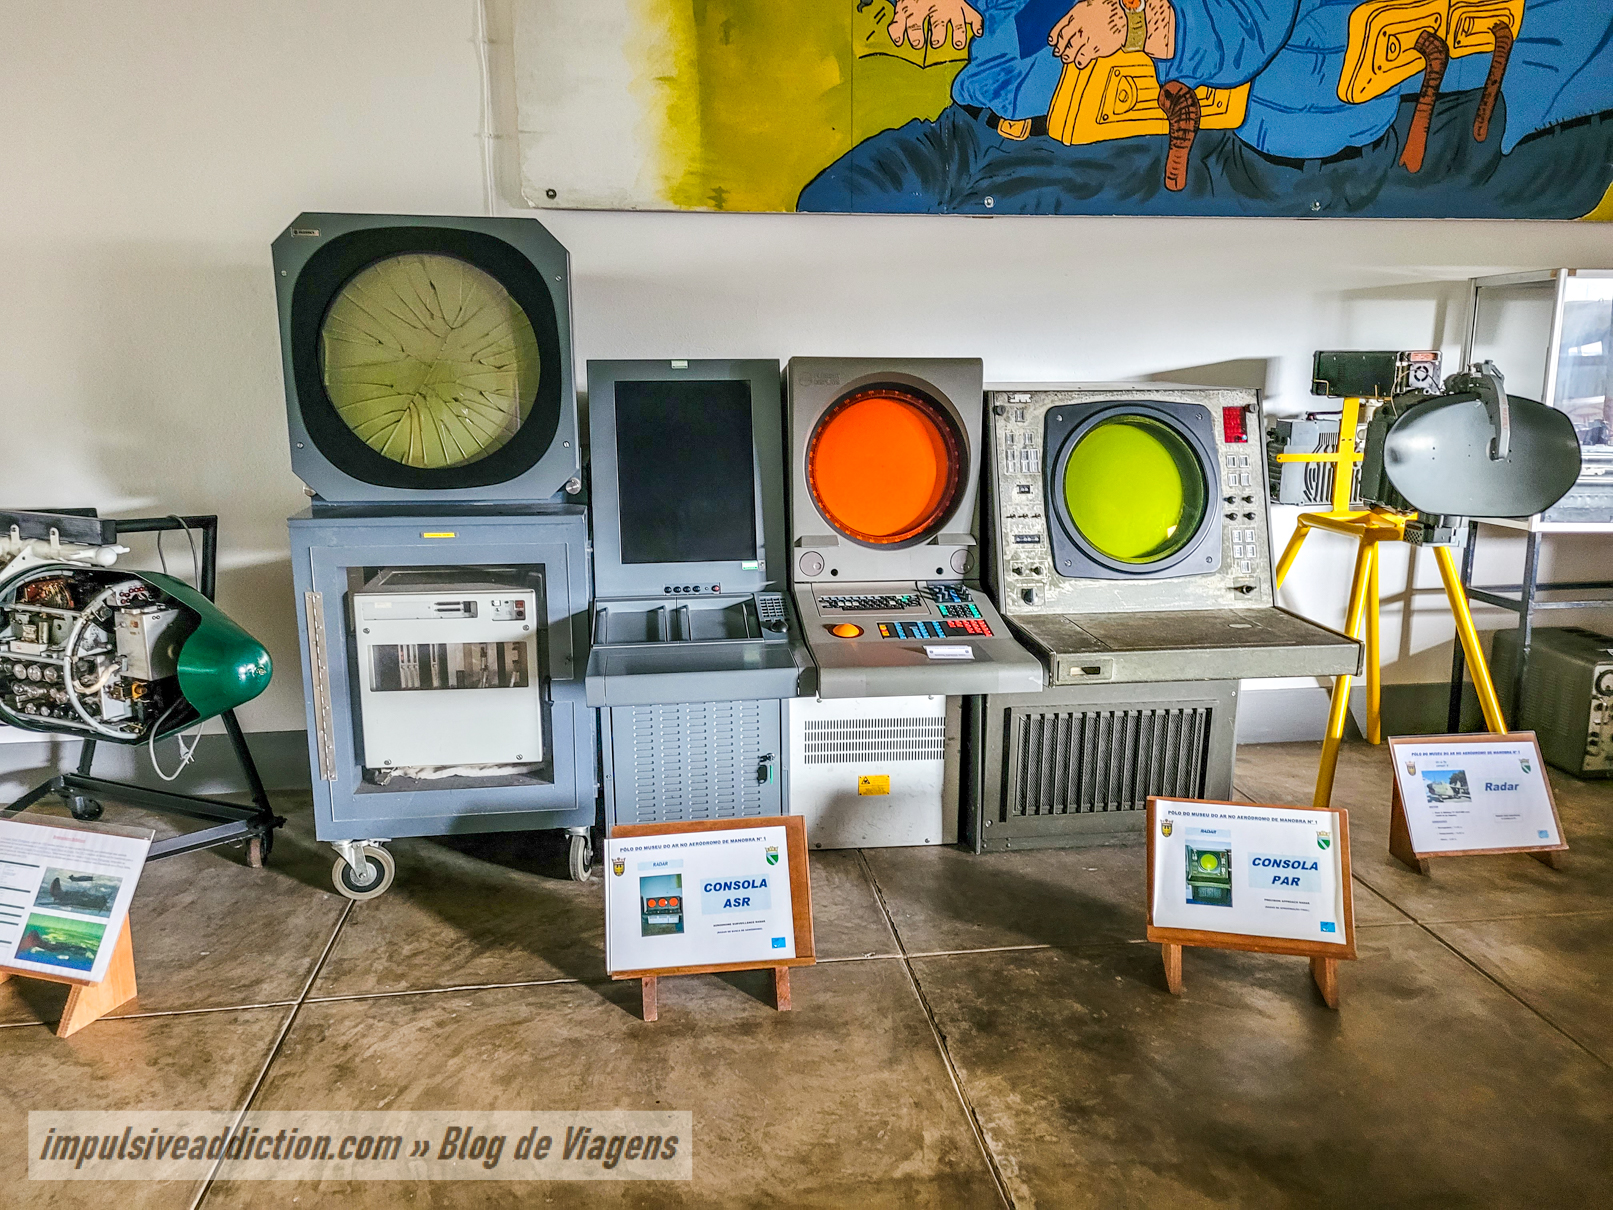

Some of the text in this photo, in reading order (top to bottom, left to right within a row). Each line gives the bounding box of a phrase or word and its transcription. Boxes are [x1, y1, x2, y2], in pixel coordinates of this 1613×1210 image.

[1484, 782, 1519, 791] Radar
[1251, 857, 1318, 871] CONSOLA
[703, 878, 768, 893] CONSOLA
[1271, 875, 1300, 887] PAR
[723, 897, 751, 909] ASR
